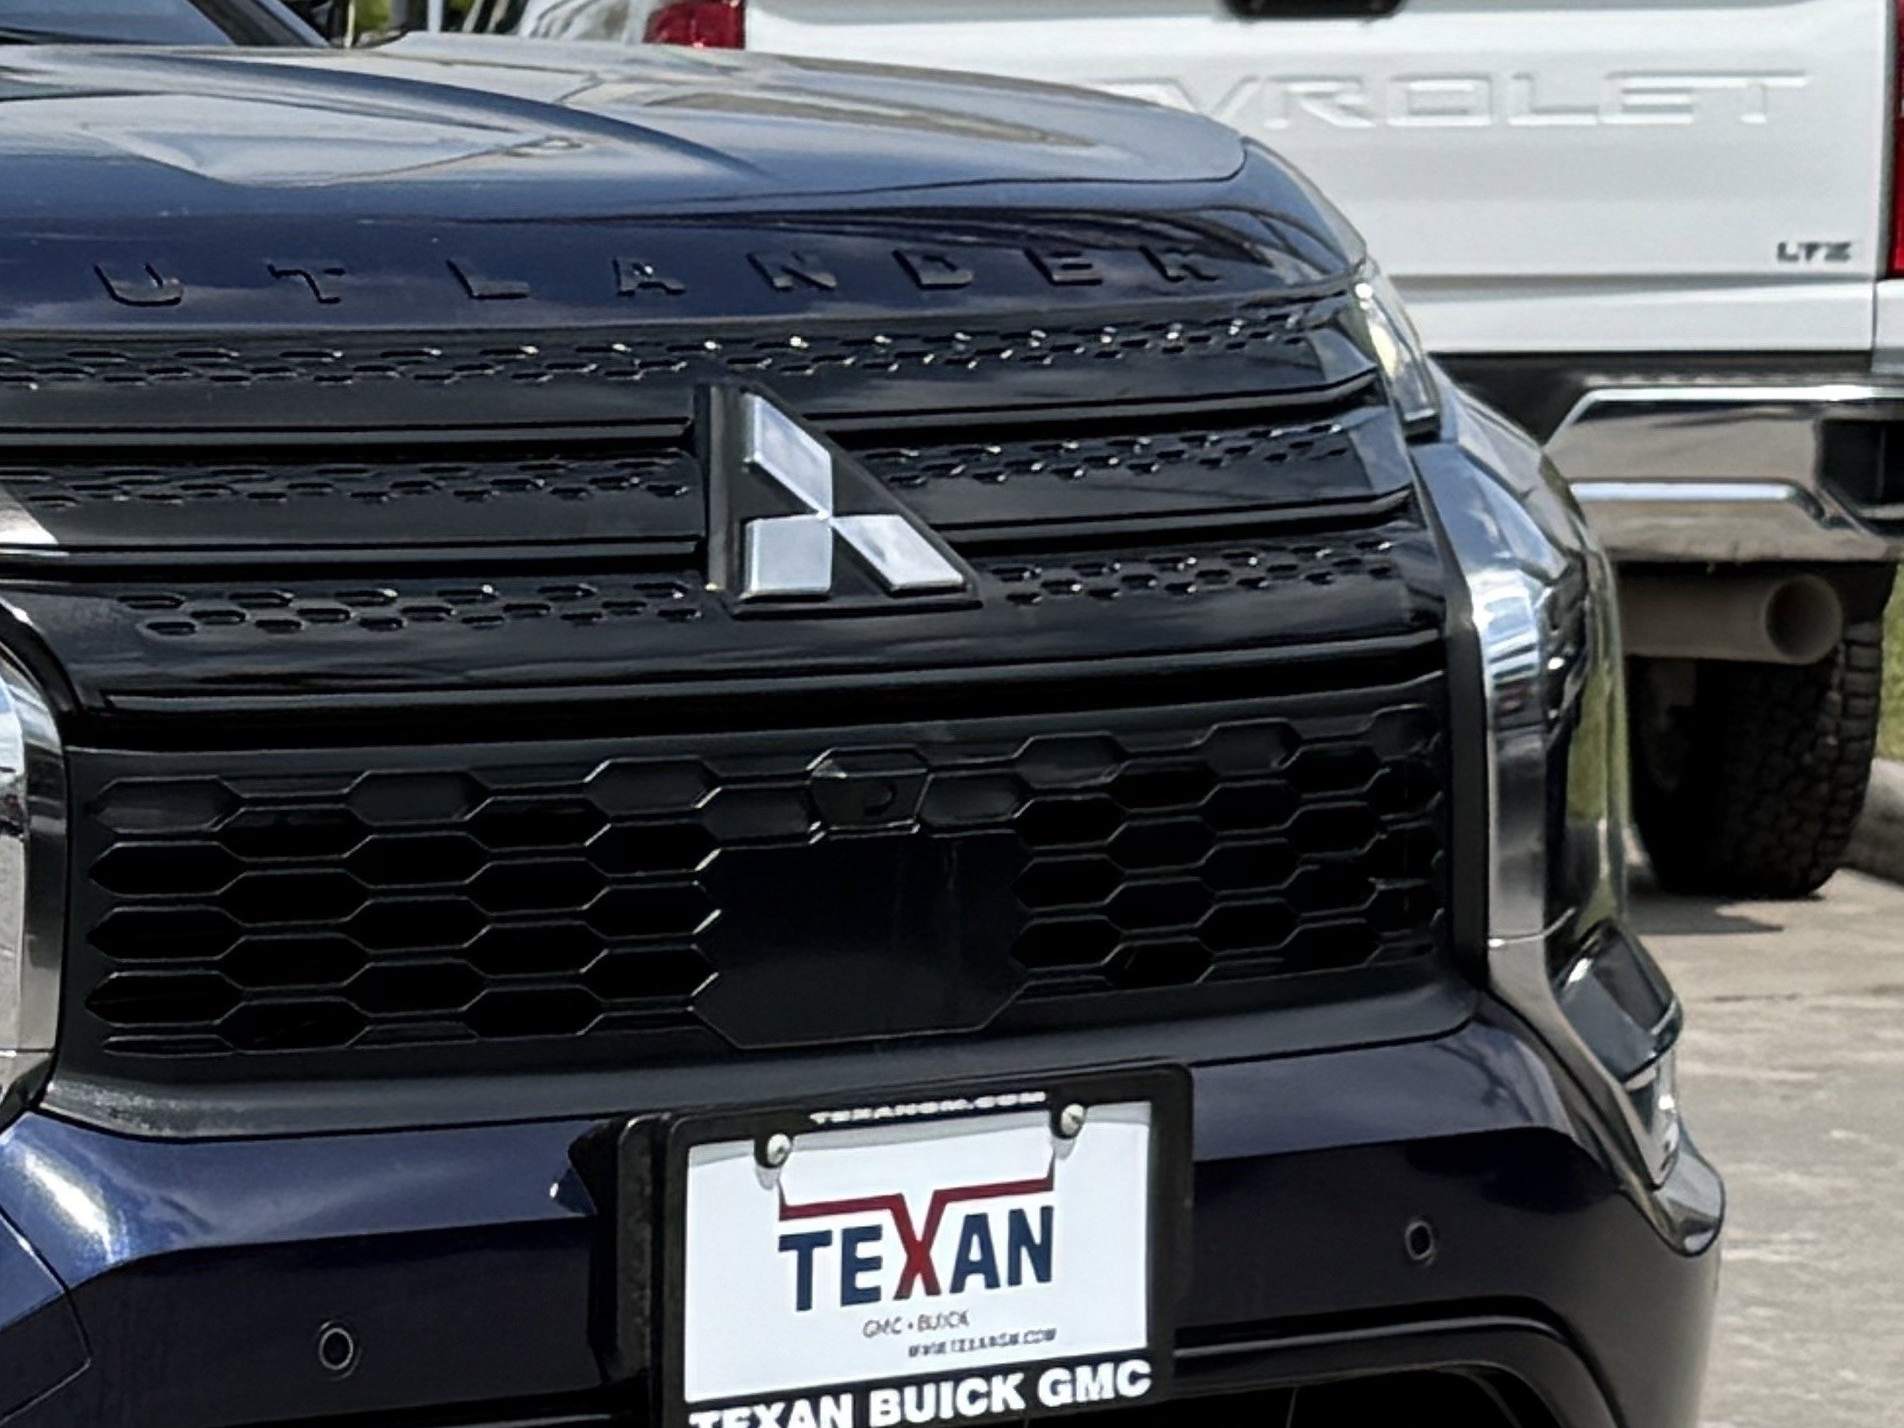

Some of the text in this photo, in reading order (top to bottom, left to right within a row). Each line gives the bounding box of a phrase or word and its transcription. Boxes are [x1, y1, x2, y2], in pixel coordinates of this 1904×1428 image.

[1087, 70, 1810, 128] VROLET
[1777, 241, 1852, 263] LTZ
[778, 1176, 1055, 1312] TEXAN
[862, 1309, 971, 1339] GMC BUICK
[868, 1372, 1026, 1428] BUICK
[1036, 1358, 1153, 1409] GMC
